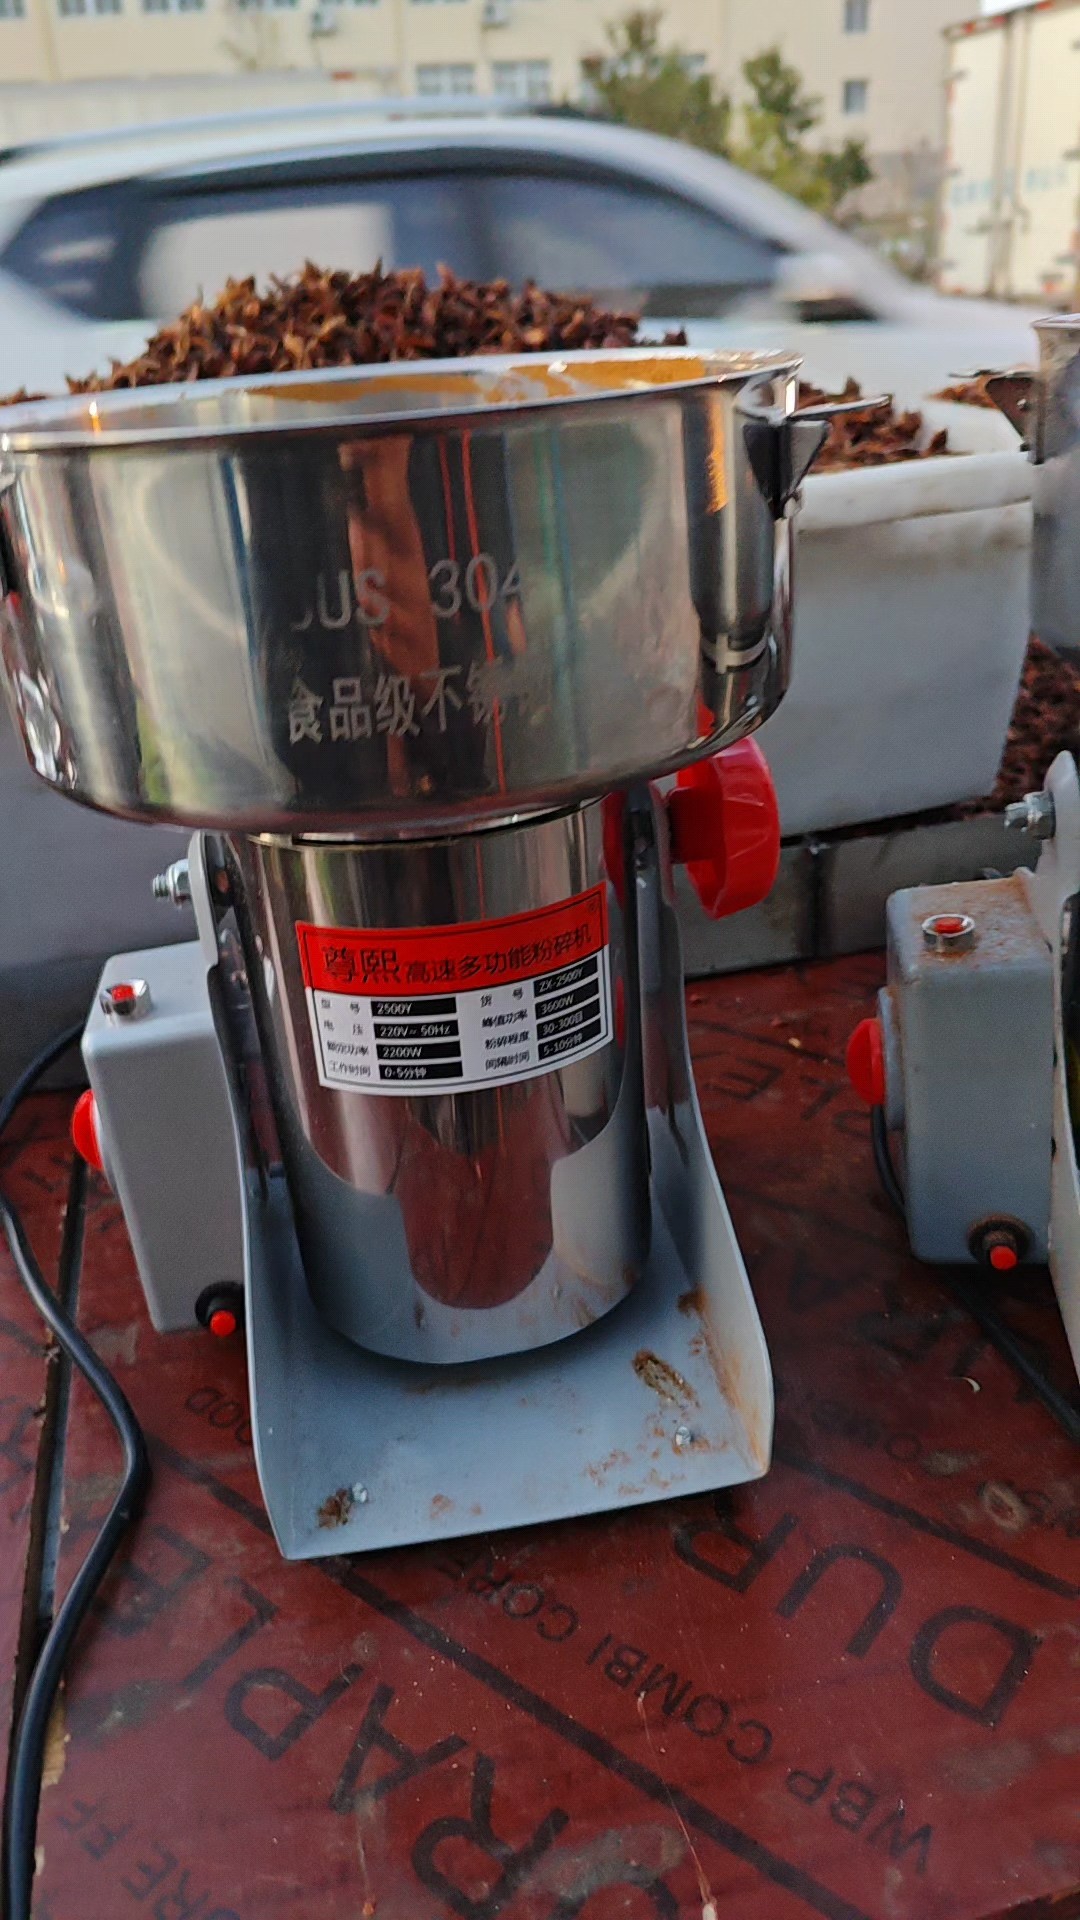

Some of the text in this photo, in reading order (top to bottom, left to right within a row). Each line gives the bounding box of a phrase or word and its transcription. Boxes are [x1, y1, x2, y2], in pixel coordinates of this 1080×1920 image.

[405, 923, 593, 984] 高速多功能粉碎机
[382, 1046, 423, 1058] 2200W
[587, 1633, 774, 1765] COMBI
[786, 1766, 933, 1876] WBP
